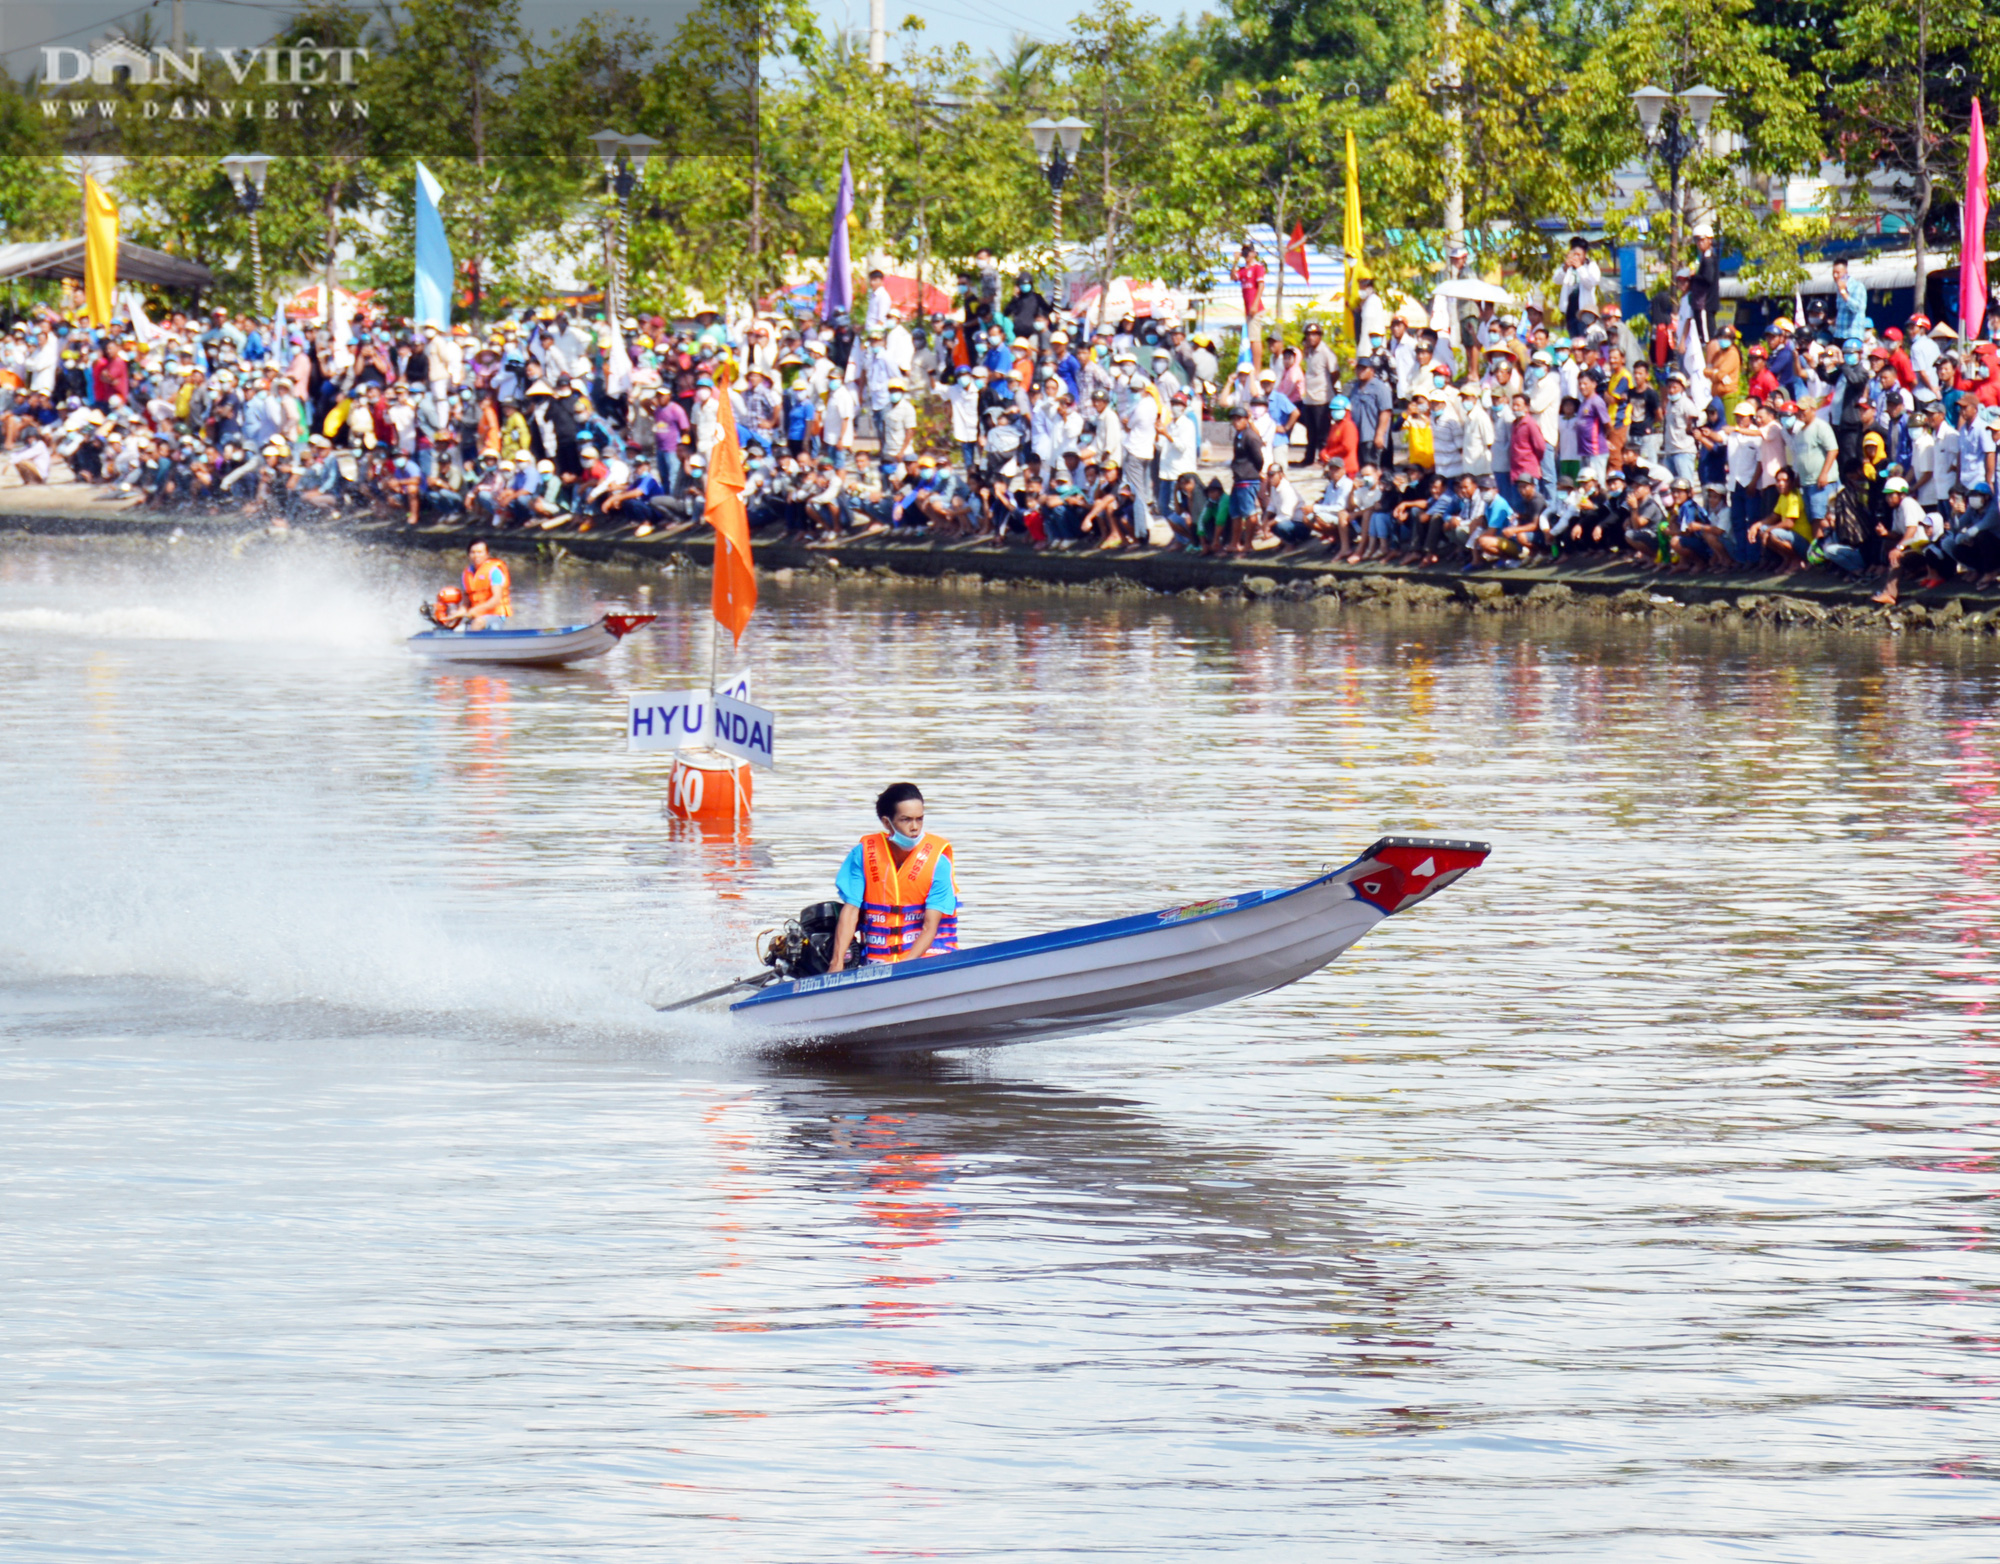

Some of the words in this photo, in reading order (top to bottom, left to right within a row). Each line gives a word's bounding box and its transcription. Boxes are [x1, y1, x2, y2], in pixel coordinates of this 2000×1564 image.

[633, 704, 703, 737] HYU
[715, 708, 772, 754] NDAI
[672, 766, 704, 812] 10
[907, 842, 933, 881] GENESIS
